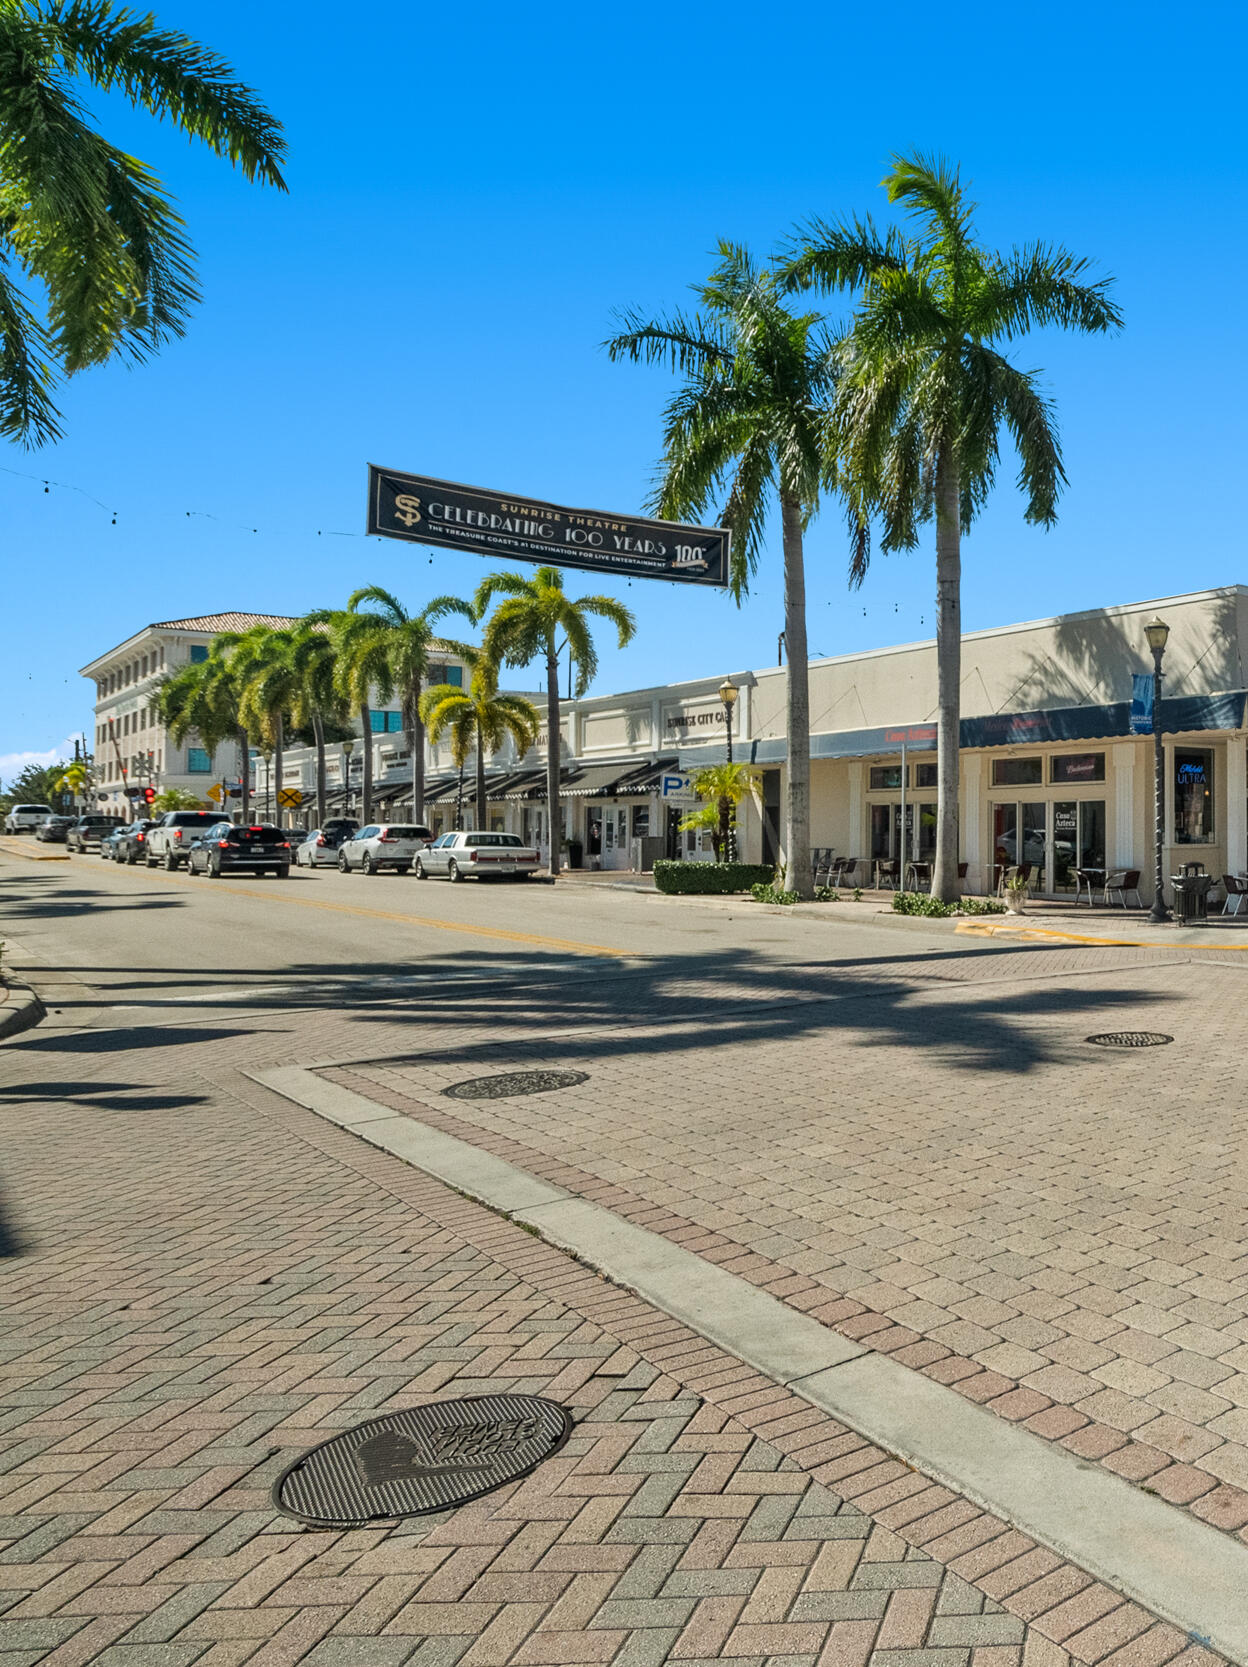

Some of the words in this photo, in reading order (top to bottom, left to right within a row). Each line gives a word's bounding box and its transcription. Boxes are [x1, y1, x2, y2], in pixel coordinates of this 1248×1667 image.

[428, 503, 554, 538] CELEBRATING
[565, 528, 603, 546] 100
[614, 535, 666, 555] YEARS
[501, 503, 561, 521] SUNRISE
[568, 516, 627, 532] THEATRE
[428, 524, 442, 532] THE
[446, 528, 485, 541] TREASURE
[487, 536, 519, 546] COAST'S
[530, 543, 577, 556] DESTINATION
[611, 556, 666, 568] ENTERTAINMENT
[697, 712, 713, 725] CITY
[1177, 773, 1207, 784] ULTRA
